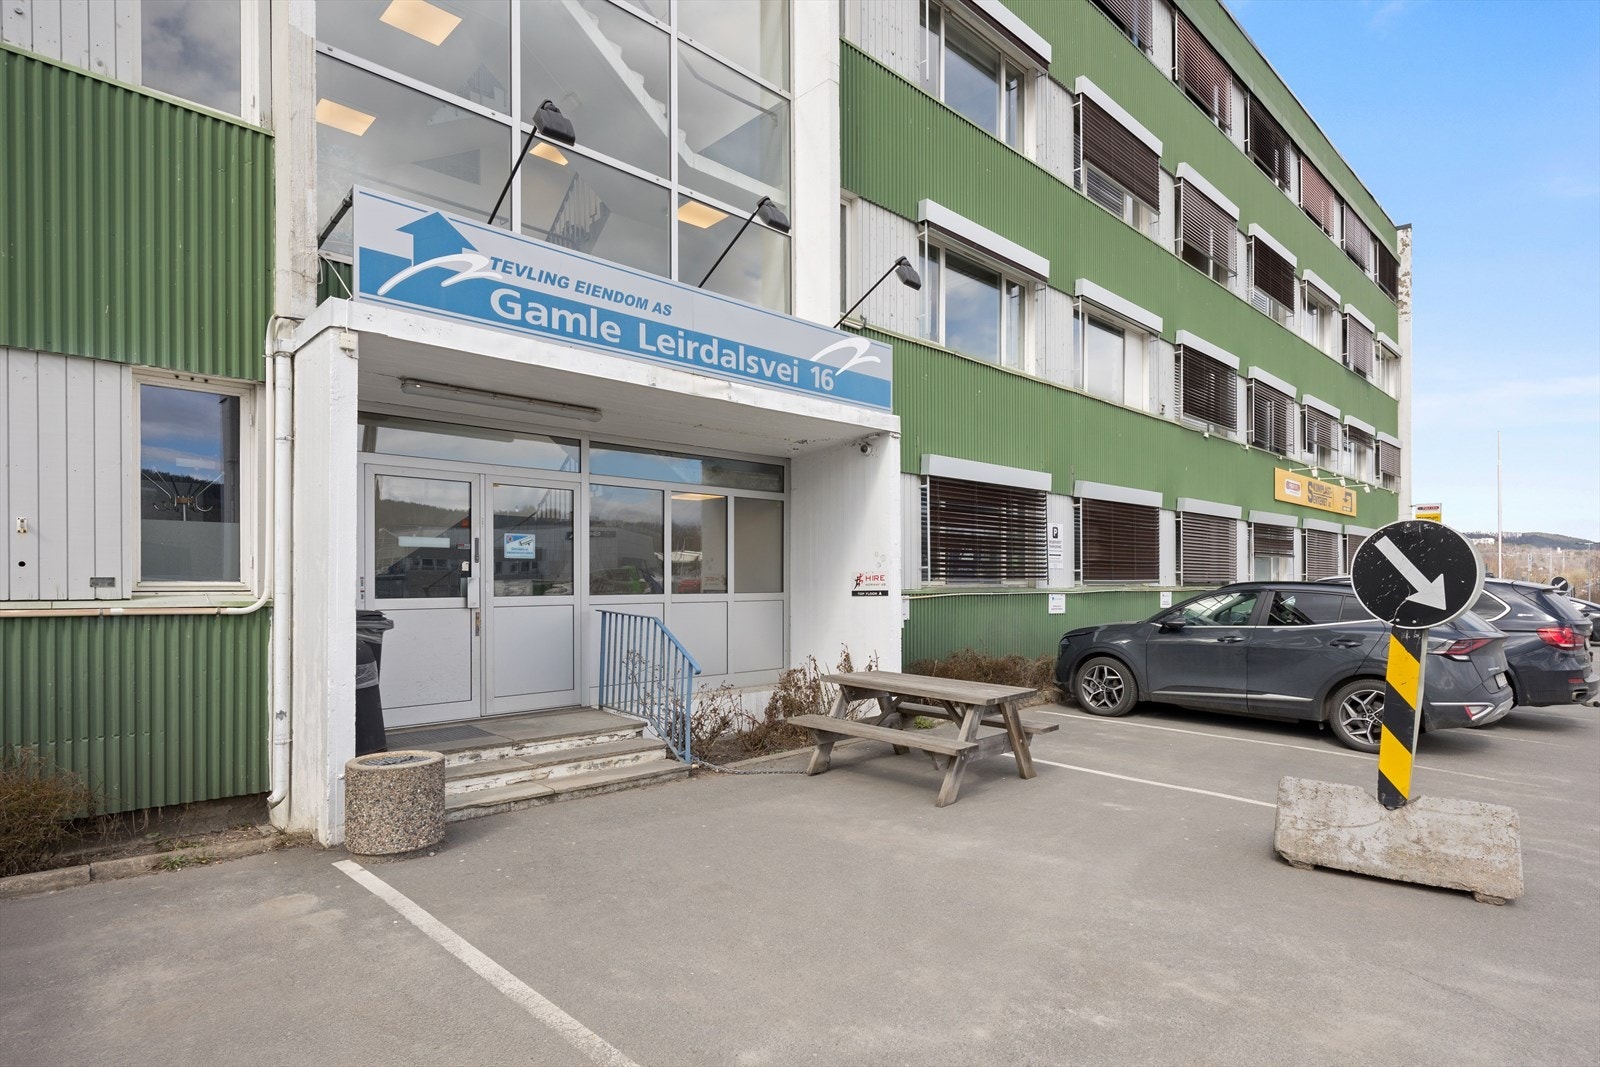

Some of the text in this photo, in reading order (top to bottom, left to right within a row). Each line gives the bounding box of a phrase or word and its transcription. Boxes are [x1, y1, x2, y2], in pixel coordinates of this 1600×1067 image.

[490, 256, 673, 317] TEVLING EIENDOM AS
[490, 288, 835, 391] Gamle Leirdalsvei 16
[865, 574, 885, 582] HIRE
